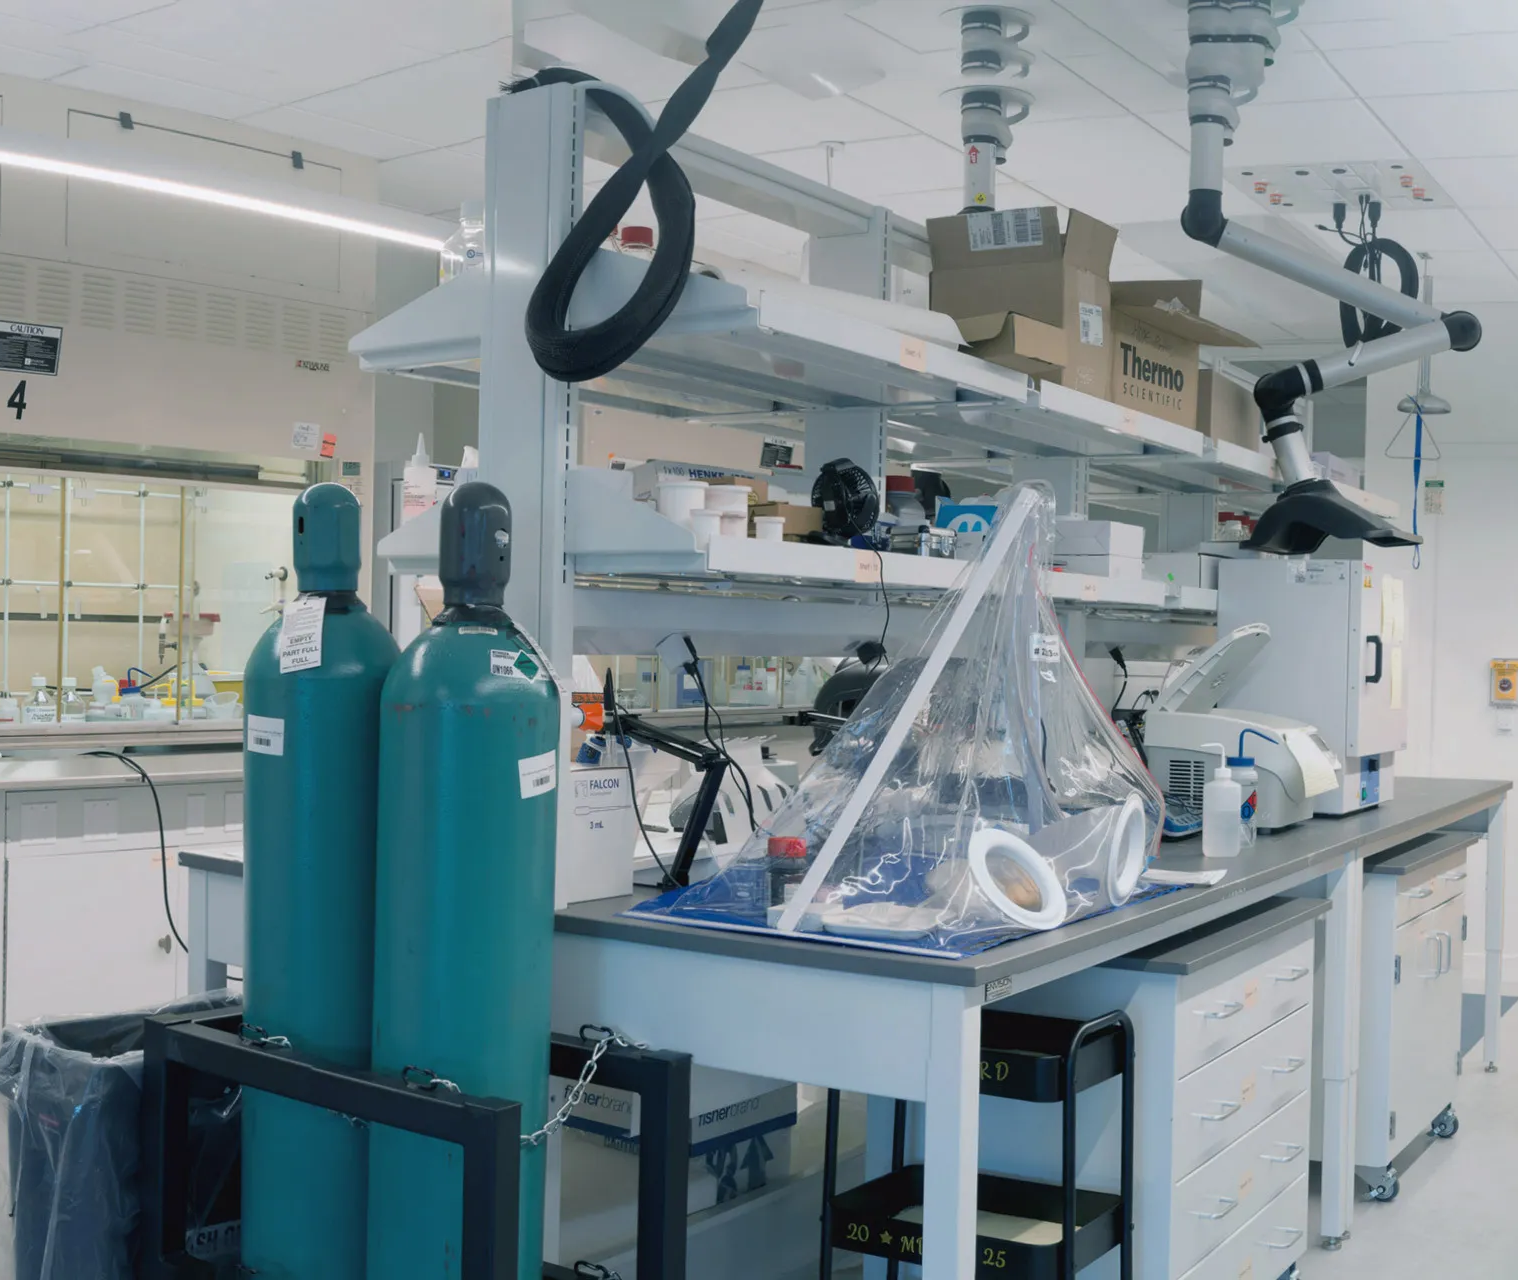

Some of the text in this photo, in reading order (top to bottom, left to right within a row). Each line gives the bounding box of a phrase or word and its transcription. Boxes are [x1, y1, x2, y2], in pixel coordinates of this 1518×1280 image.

[10, 324, 44, 335] CAUTION
[1120, 342, 1184, 393] Thermo
[7, 380, 27, 420] 4
[1123, 382, 1182, 410] SCIENTIFIC
[290, 635, 313, 645] EMPTY
[282, 644, 319, 658] PART FULL
[291, 655, 309, 665] FULL
[589, 778, 620, 789] FALCON
[589, 821, 594, 829] 3
[846, 1223, 870, 1242] 20
[982, 1248, 1006, 1268] 25
